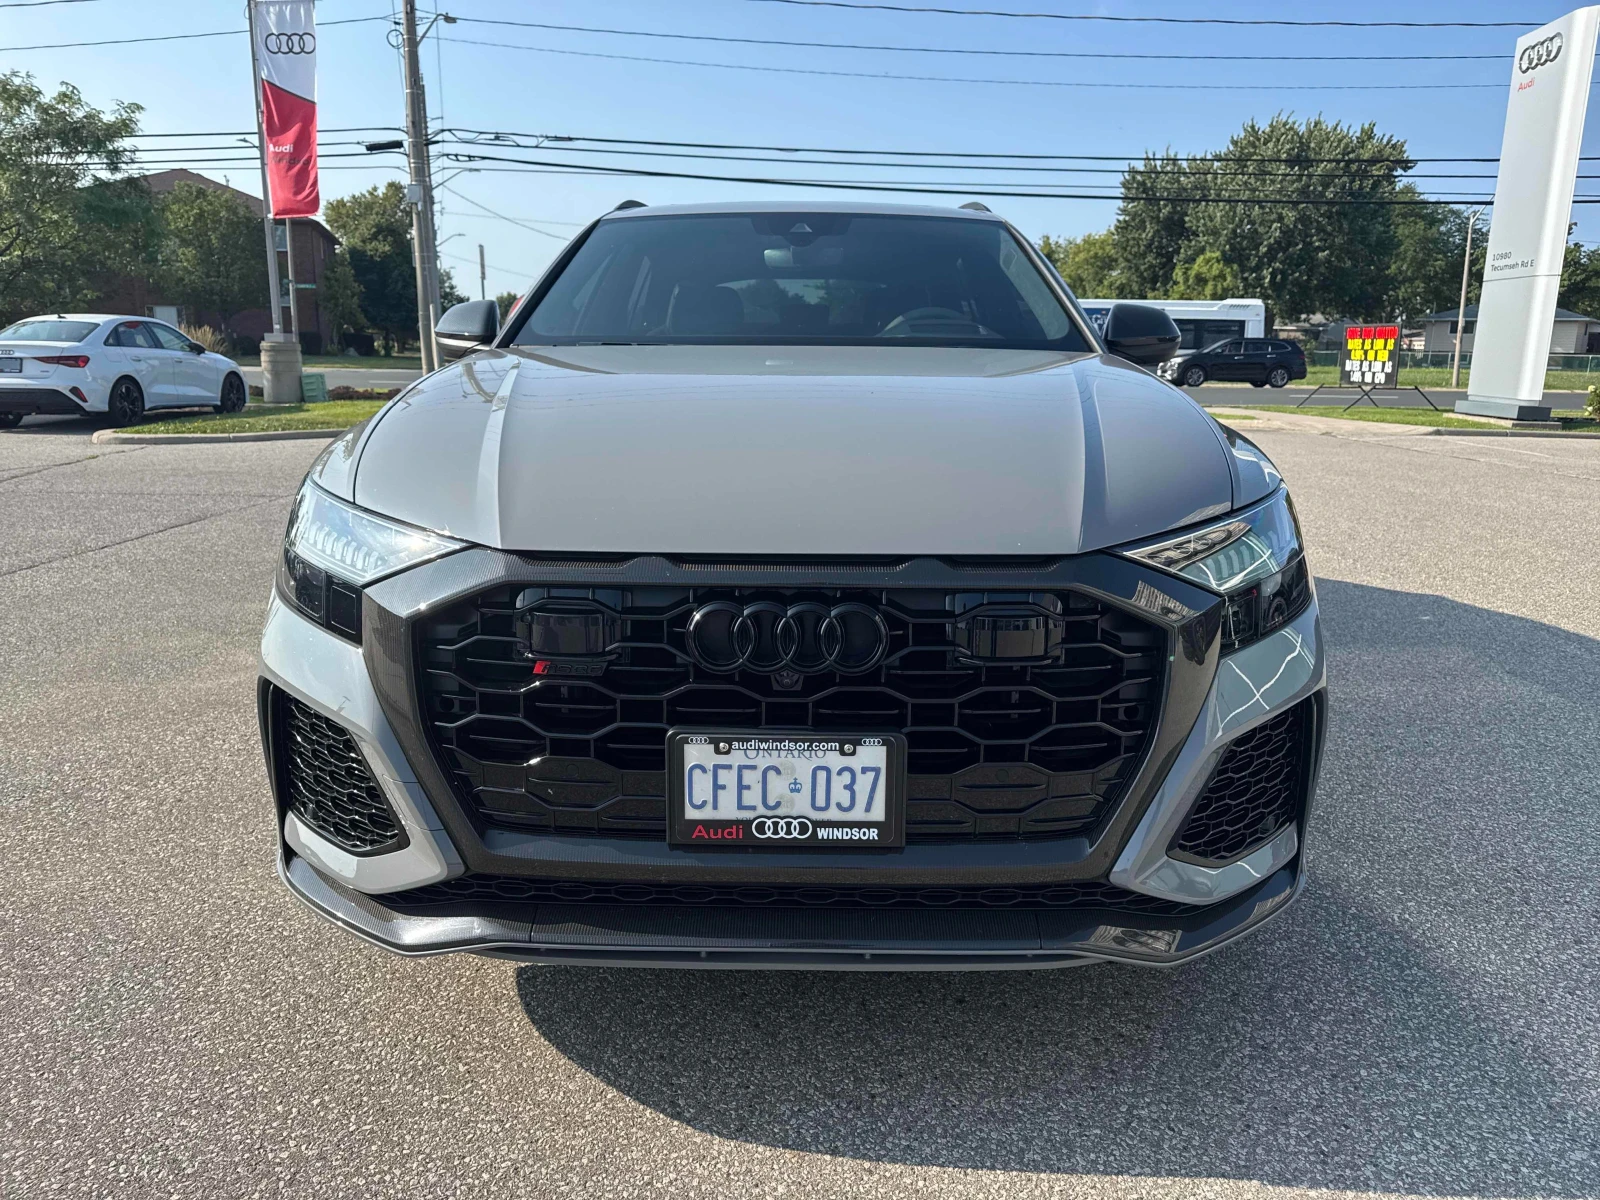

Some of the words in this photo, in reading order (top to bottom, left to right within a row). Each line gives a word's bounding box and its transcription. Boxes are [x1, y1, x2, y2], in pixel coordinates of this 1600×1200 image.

[1517, 77, 1535, 92] Audi
[269, 143, 294, 153] Audi
[1491, 261, 1519, 272] Tecumseh
[1520, 260, 1529, 269] Rd
[1530, 259, 1535, 267] E
[1364, 338, 1372, 350] AS
[1386, 338, 1395, 350] AS
[1362, 360, 1370, 372] AS
[1384, 360, 1392, 373] AS
[732, 739, 839, 751] audiwindsor.com
[687, 762, 782, 811] CFEC
[810, 765, 881, 813] 037
[692, 824, 743, 839] Audi
[817, 827, 878, 840] WINDSOR
